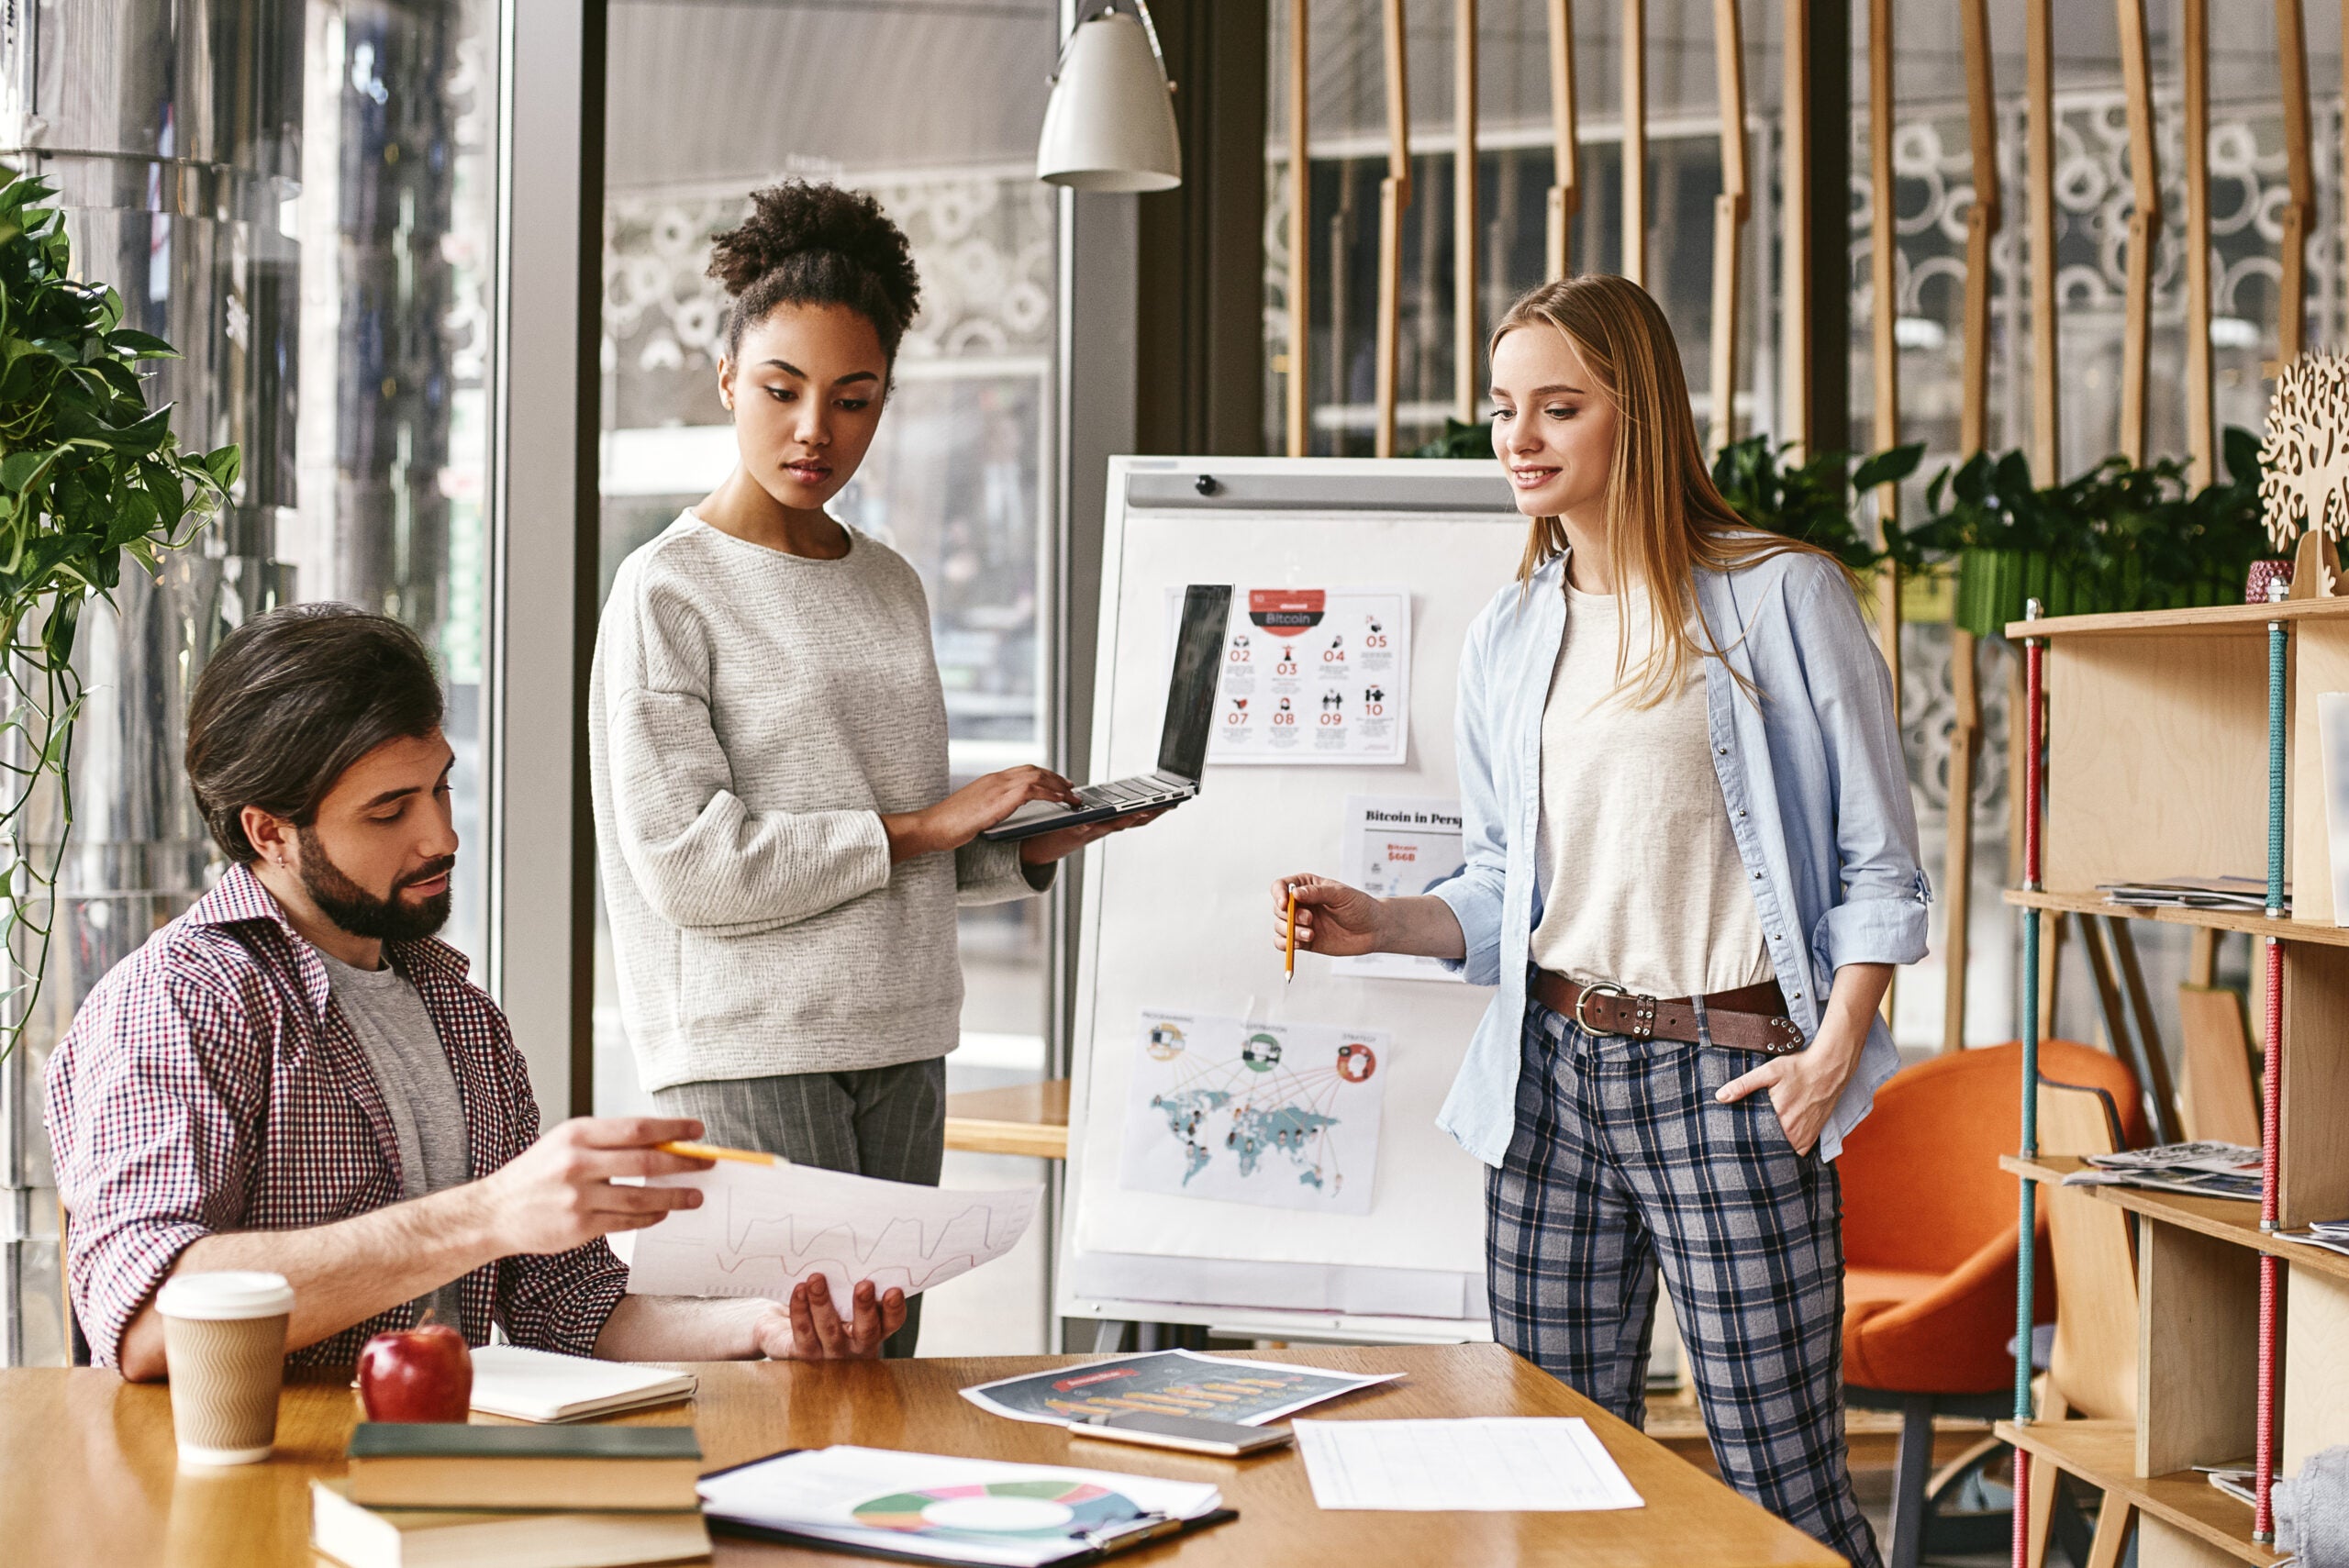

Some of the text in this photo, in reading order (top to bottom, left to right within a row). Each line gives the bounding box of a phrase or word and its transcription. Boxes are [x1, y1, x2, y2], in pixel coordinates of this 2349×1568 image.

[1265, 612, 1311, 625] Bitcoin
[1366, 635, 1387, 648] 05
[1230, 650, 1250, 662] 02
[1323, 650, 1345, 662] 04
[1276, 662, 1297, 675] 03
[1365, 704, 1383, 716] 10
[1228, 713, 1249, 725] 07
[1274, 713, 1295, 725] 08
[1320, 713, 1341, 726] 09
[1365, 810, 1411, 823] Bitcoin
[1415, 812, 1428, 824] in
